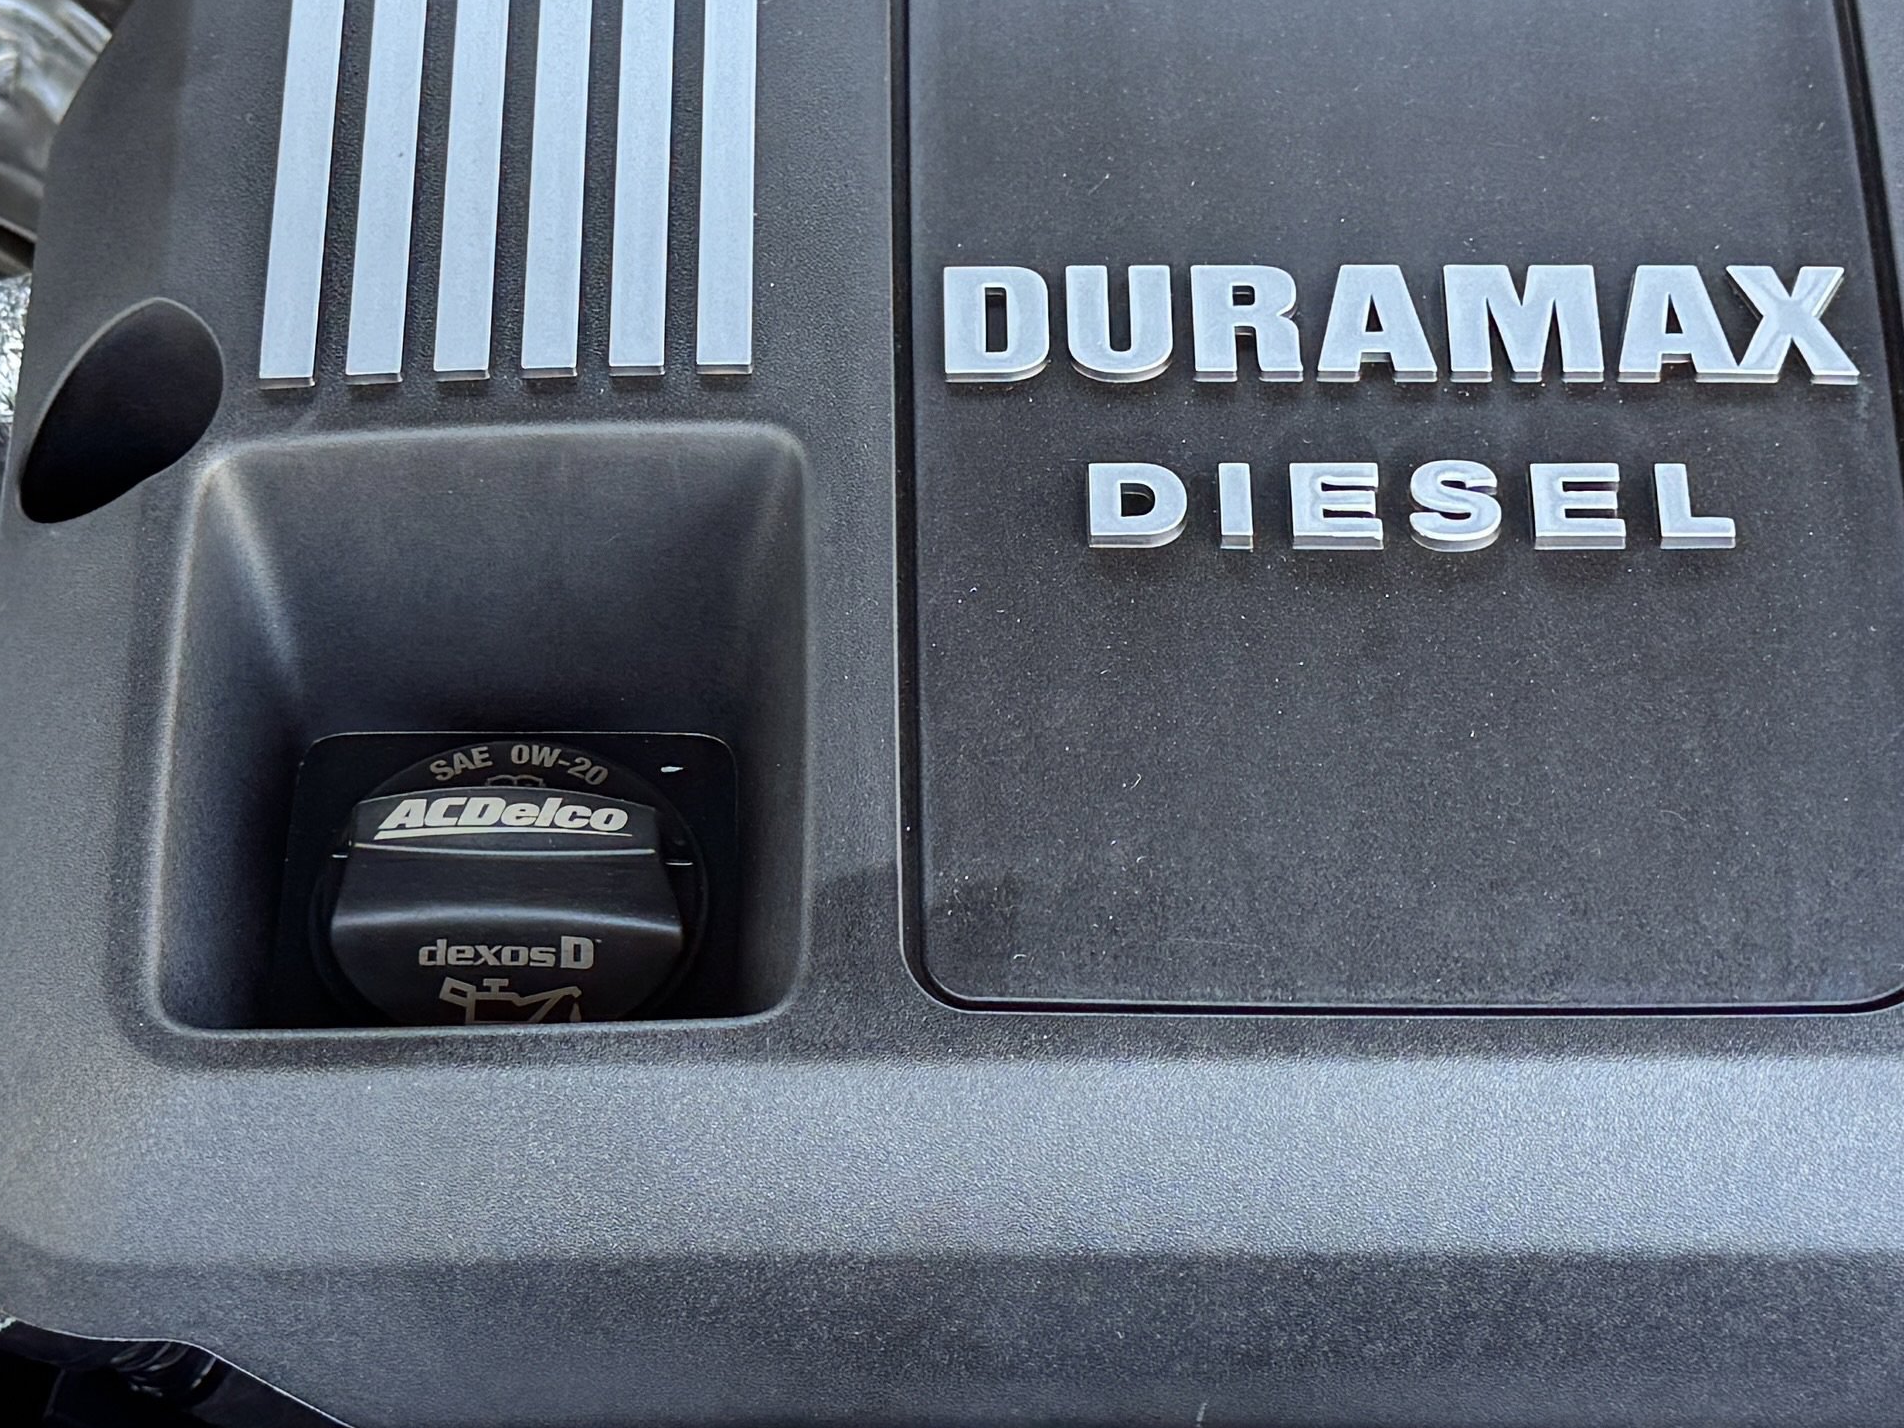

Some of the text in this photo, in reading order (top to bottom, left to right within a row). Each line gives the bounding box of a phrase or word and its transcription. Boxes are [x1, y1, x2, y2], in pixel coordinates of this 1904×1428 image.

[943, 264, 1861, 384] DURAMAX
[1086, 459, 1737, 551] DIESEL
[429, 743, 610, 786] SAE 0W-20
[379, 796, 629, 834] ACDelco
